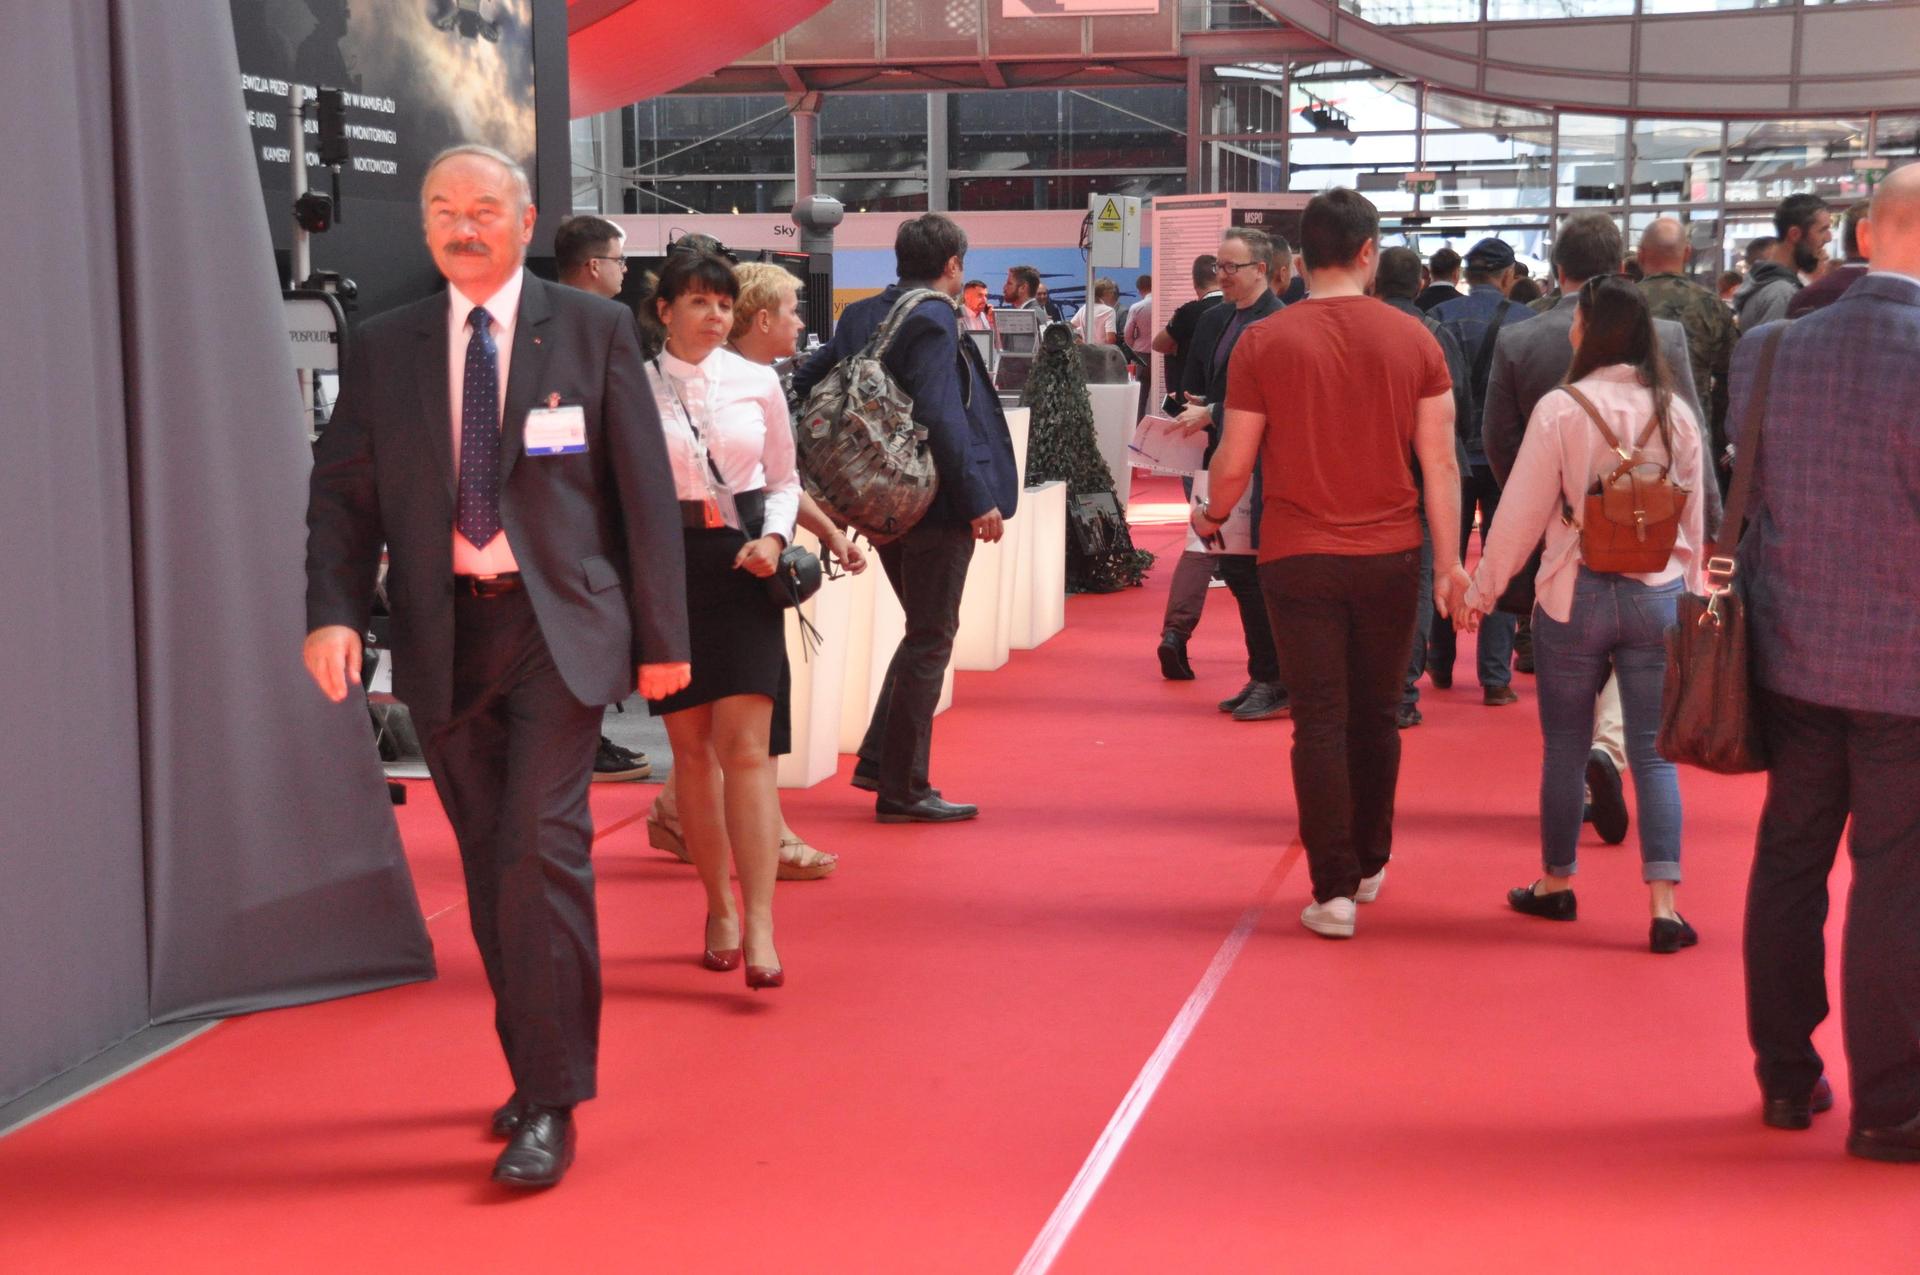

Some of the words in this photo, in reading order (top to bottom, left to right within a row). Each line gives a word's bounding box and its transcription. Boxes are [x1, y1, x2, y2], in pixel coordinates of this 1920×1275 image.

[353, 124, 397, 145] MONITORINGU
[262, 145, 291, 163] KAMERY
[354, 157, 398, 175] NOKTOWIZORY
[1244, 211, 1263, 225] MSPO
[774, 225, 796, 238] Sky
